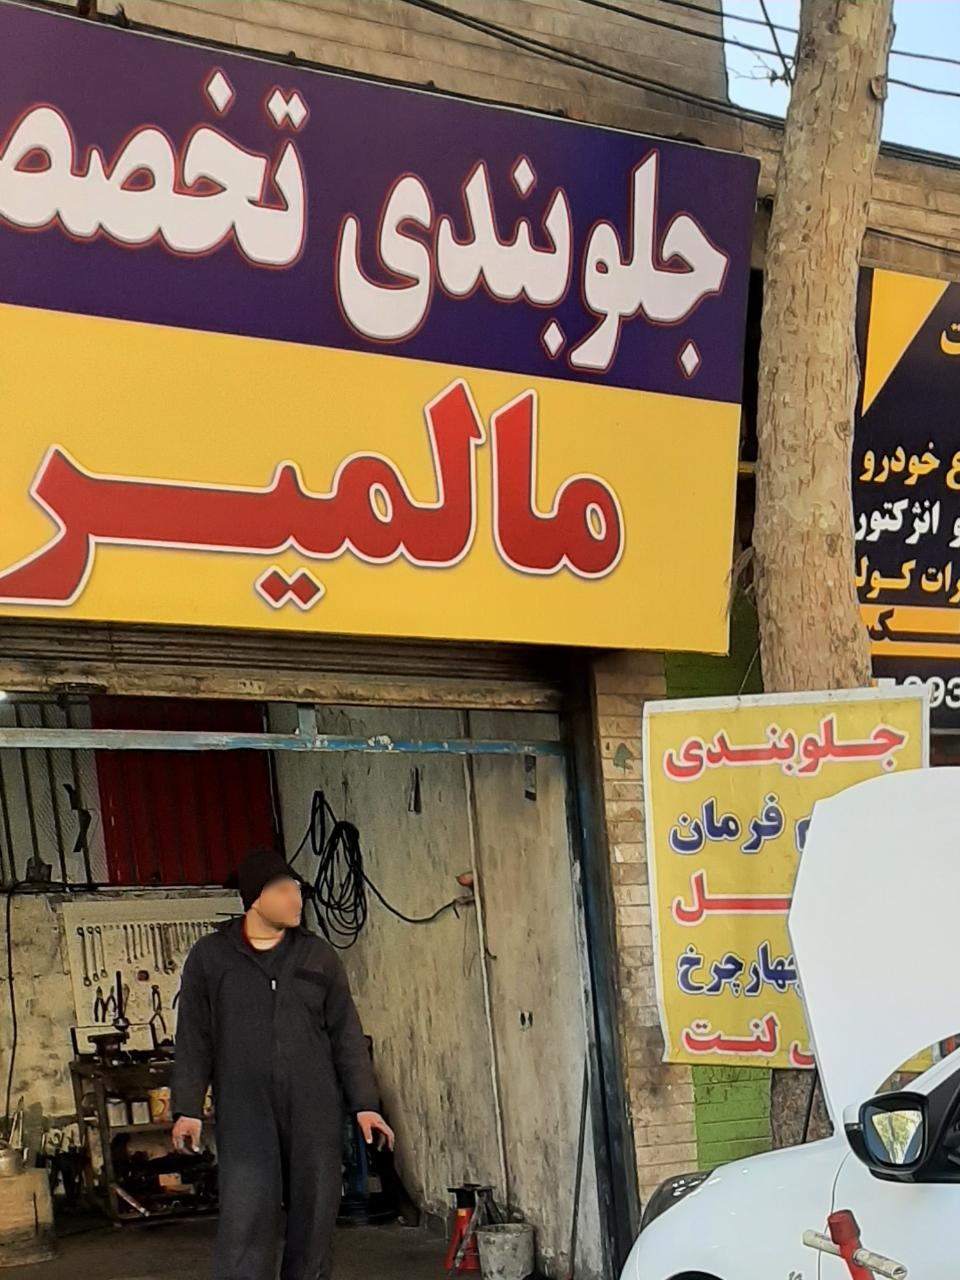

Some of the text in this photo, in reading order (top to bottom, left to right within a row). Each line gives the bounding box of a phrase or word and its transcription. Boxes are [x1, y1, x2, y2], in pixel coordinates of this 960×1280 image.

[0, 69, 729, 377] جلوبندی تخصص
[859, 442, 940, 486] خودرو
[854, 498, 940, 545] انژکتور
[855, 554, 917, 599] کول
[665, 715, 906, 780] جلوبندی
[670, 794, 783, 854] فرمان
[682, 1012, 780, 1056] لنت
